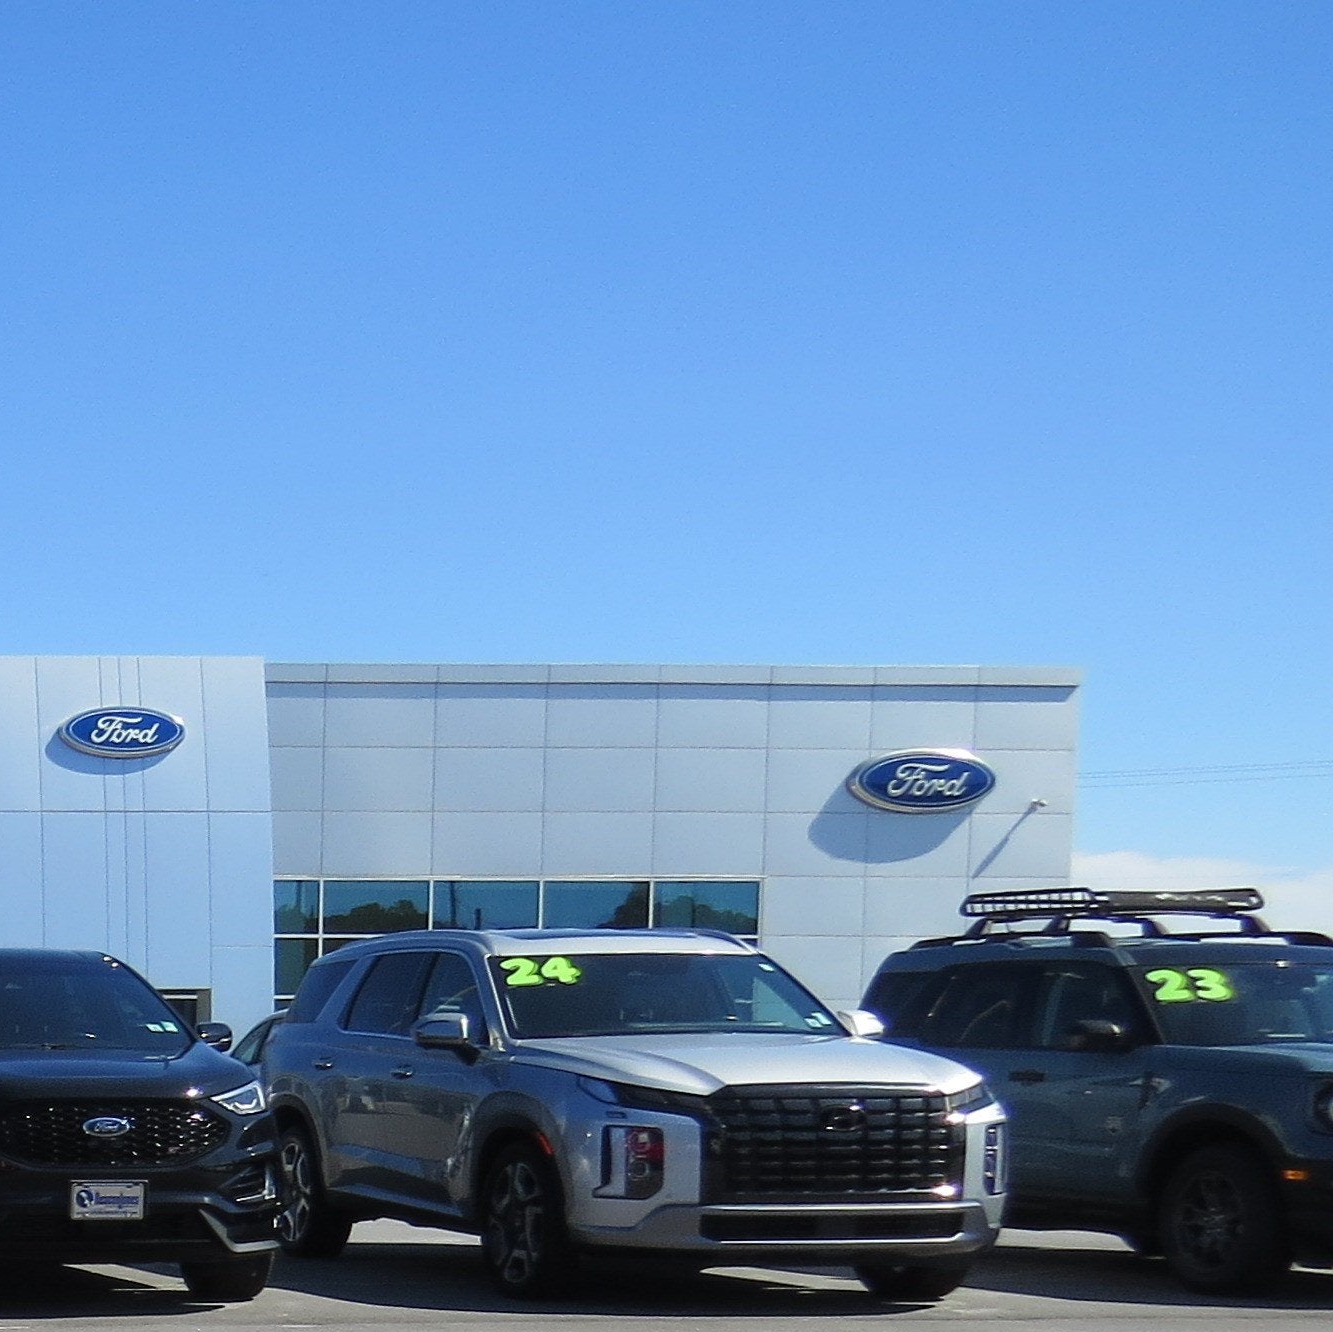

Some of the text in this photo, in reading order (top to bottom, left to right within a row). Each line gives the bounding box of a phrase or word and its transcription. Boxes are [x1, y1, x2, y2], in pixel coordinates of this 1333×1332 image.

[90, 715, 160, 744] Ford
[886, 762, 971, 798] Ford
[499, 956, 582, 986] 24
[1144, 967, 1233, 1003] 23
